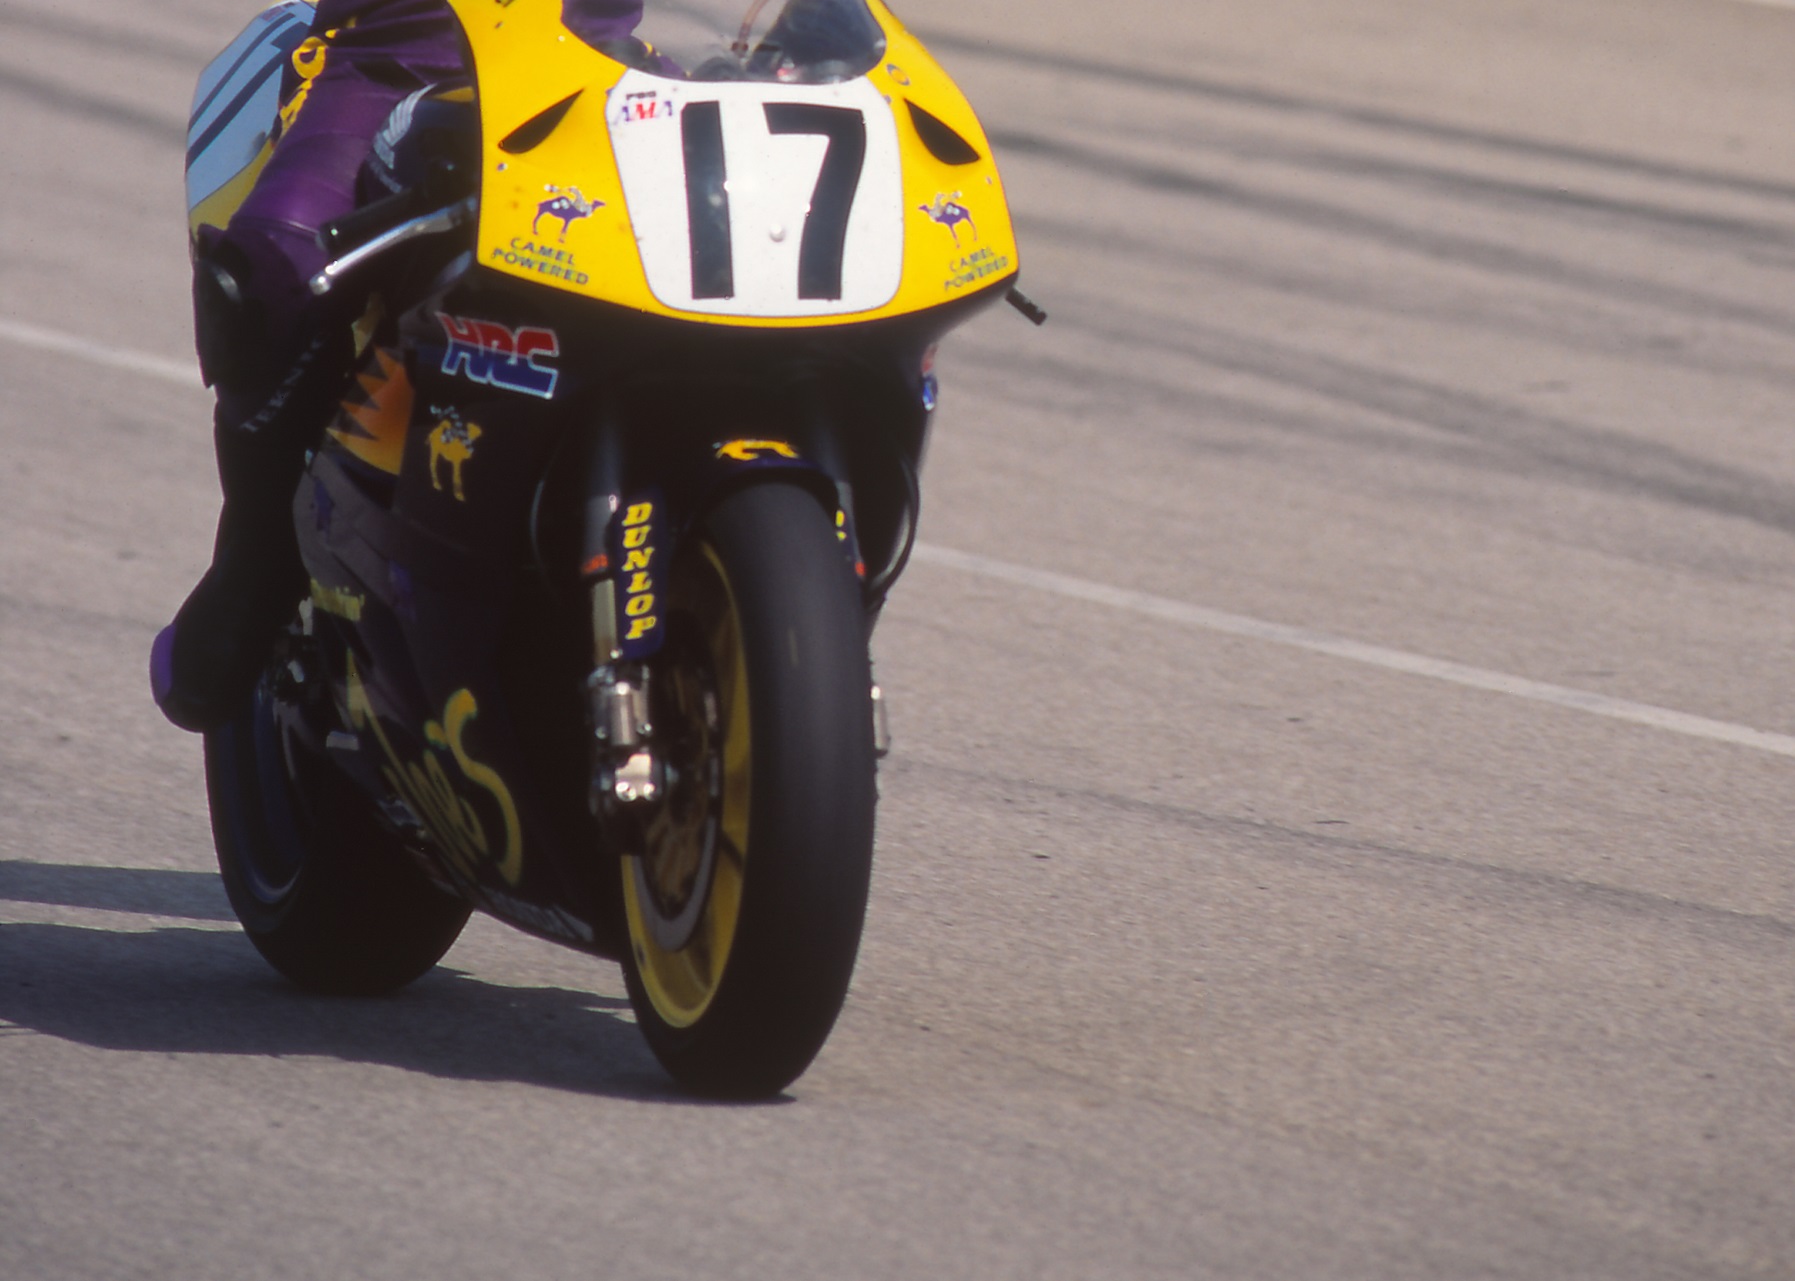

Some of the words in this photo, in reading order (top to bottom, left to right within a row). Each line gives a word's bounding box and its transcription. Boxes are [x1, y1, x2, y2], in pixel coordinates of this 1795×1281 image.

[681, 100, 867, 301] 17
[491, 247, 589, 285] POWERED
[510, 237, 575, 266] CAMEL
[949, 246, 995, 273] CAMEL
[944, 255, 1009, 291] POWERED
[434, 312, 560, 399] HRC
[622, 502, 657, 640] DUNLOP
